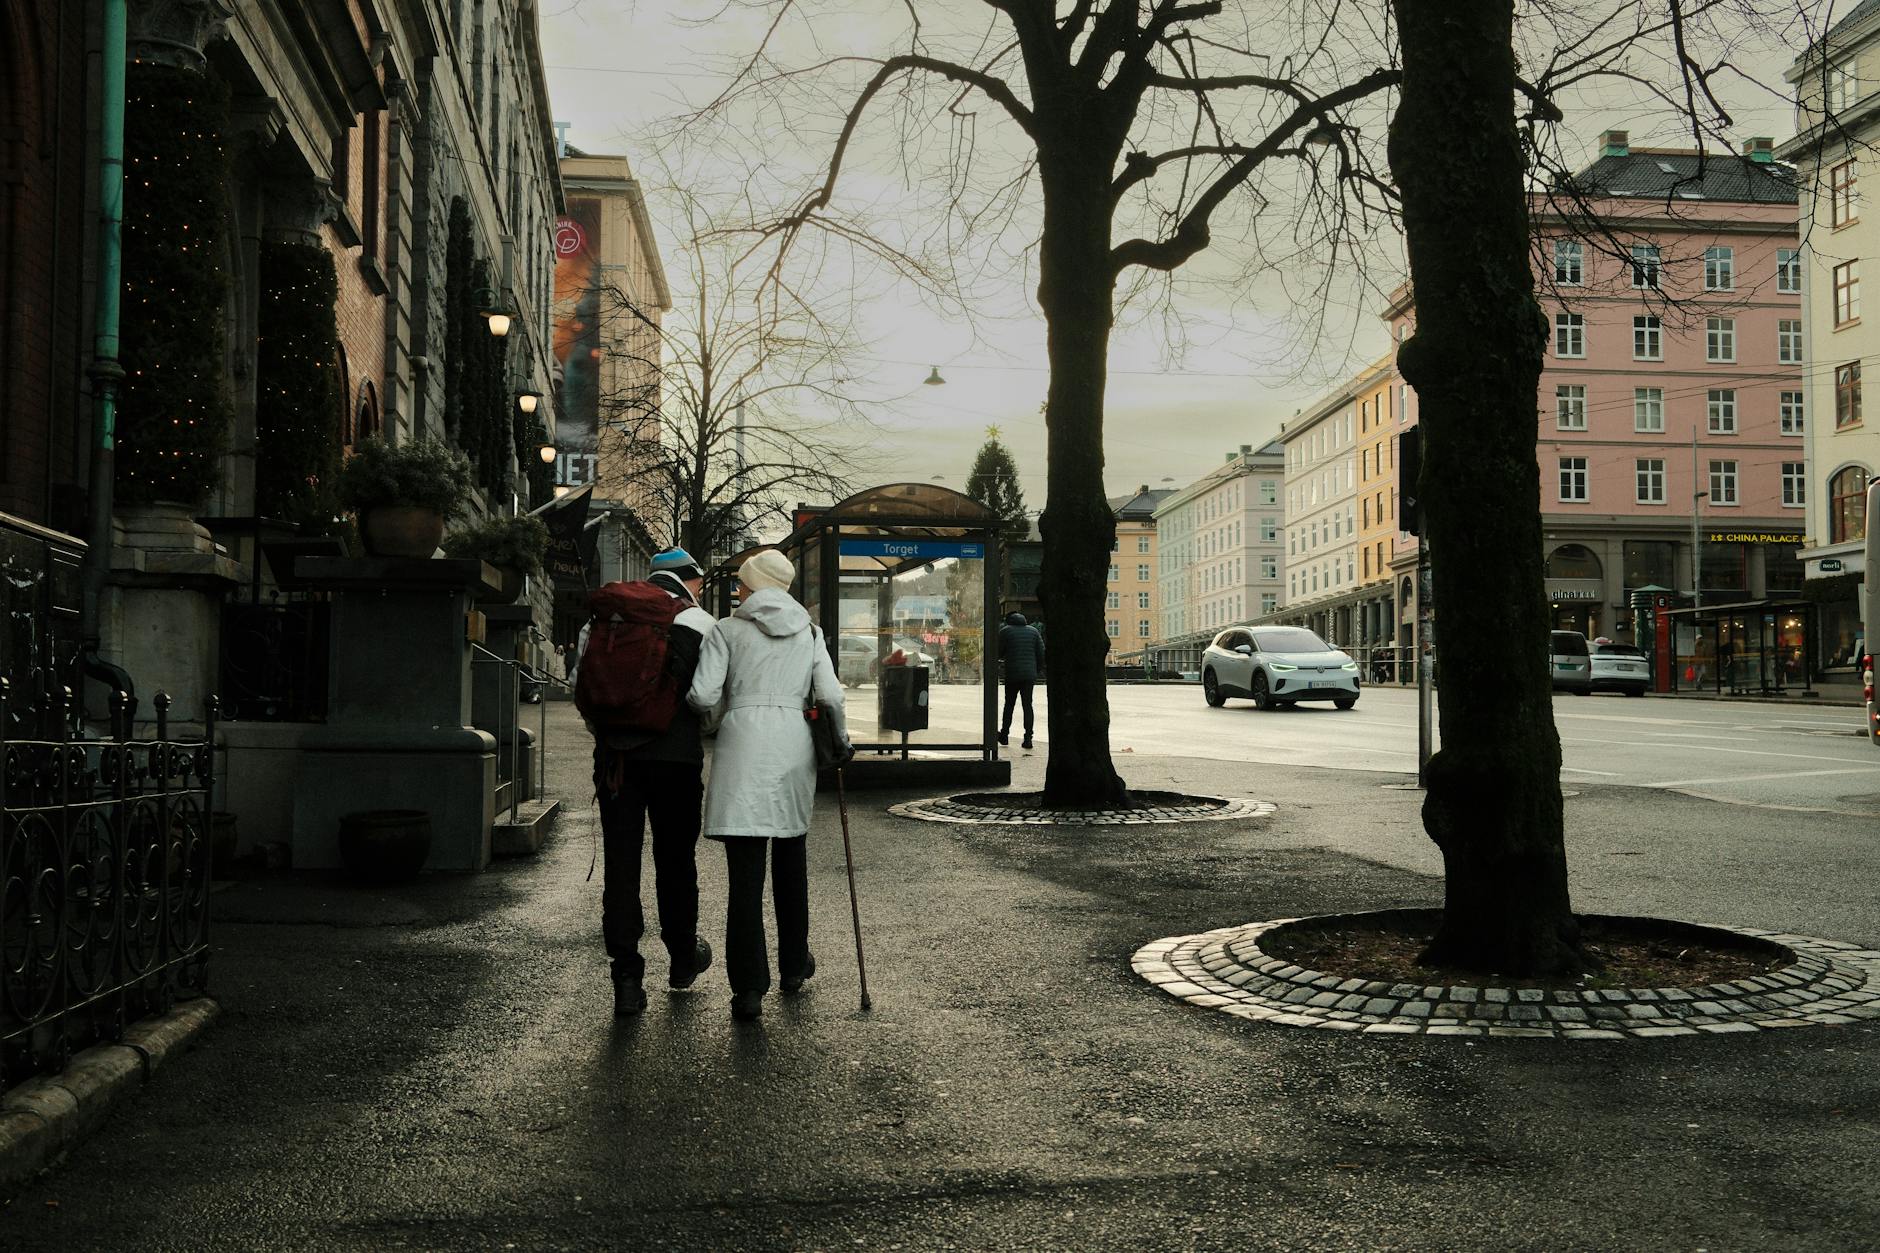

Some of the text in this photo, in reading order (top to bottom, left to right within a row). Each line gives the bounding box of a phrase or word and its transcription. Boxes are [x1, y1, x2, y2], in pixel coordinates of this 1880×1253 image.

[1726, 534, 1758, 542] CHINA
[1760, 534, 1799, 543] PALACE
[883, 543, 919, 556] Torget
[1822, 561, 1840, 569] norli
[1658, 597, 1665, 607] E
